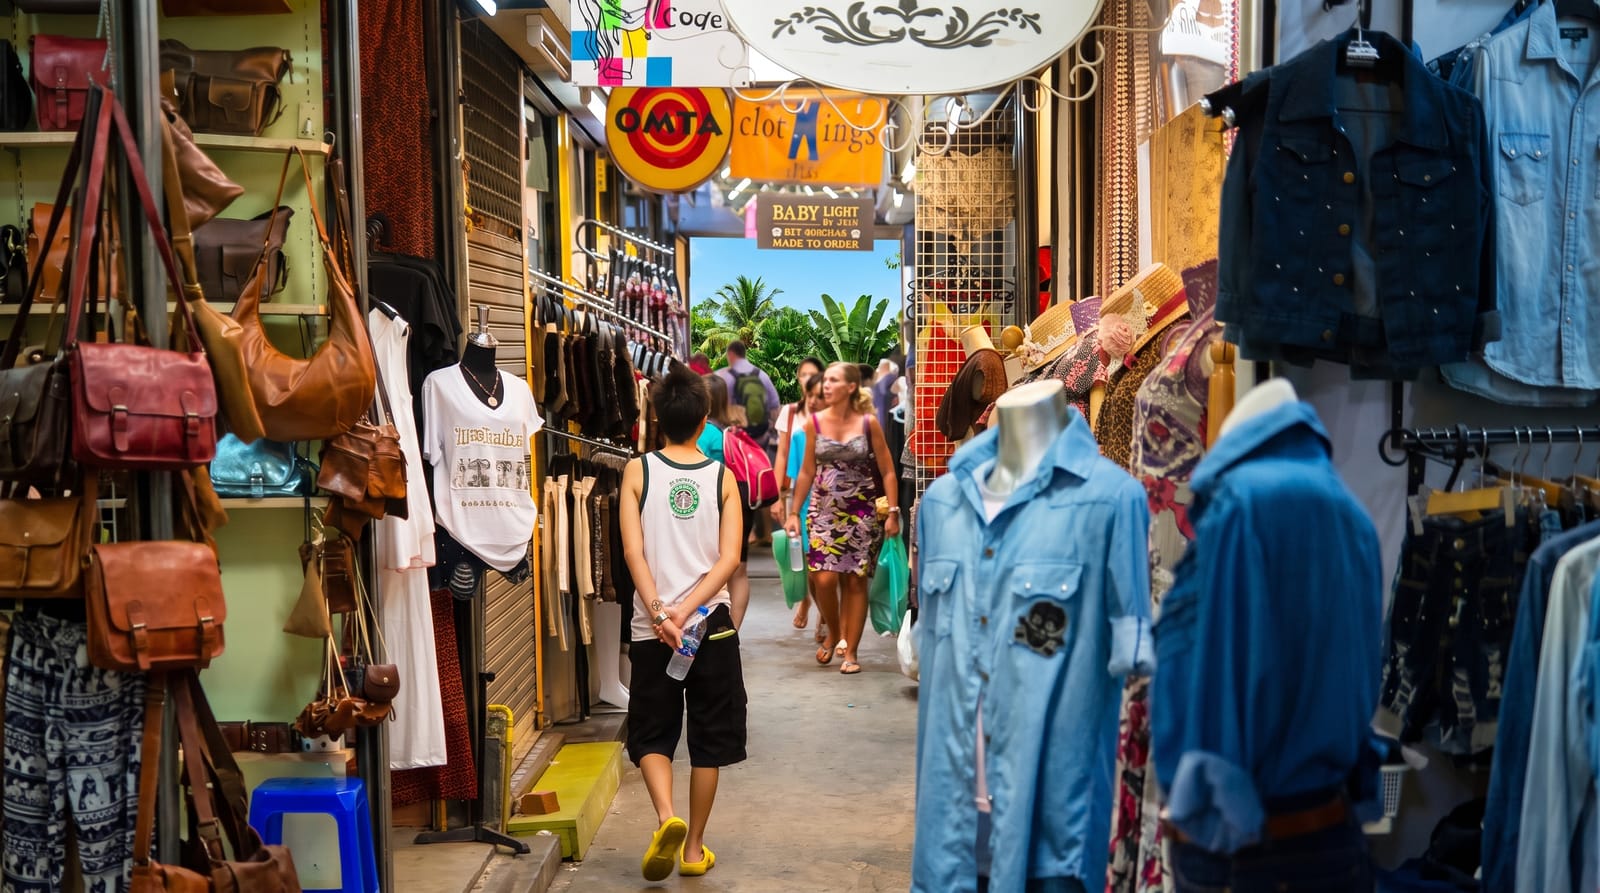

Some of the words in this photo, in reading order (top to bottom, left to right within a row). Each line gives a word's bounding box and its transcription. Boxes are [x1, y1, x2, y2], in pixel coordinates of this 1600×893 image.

[615, 107, 723, 136] OMTA
[772, 204, 820, 221] BABY
[823, 205, 860, 217] LIGHT
[772, 239, 804, 248] MADE
[806, 239, 821, 248] TO
[823, 239, 859, 249] ORDER
